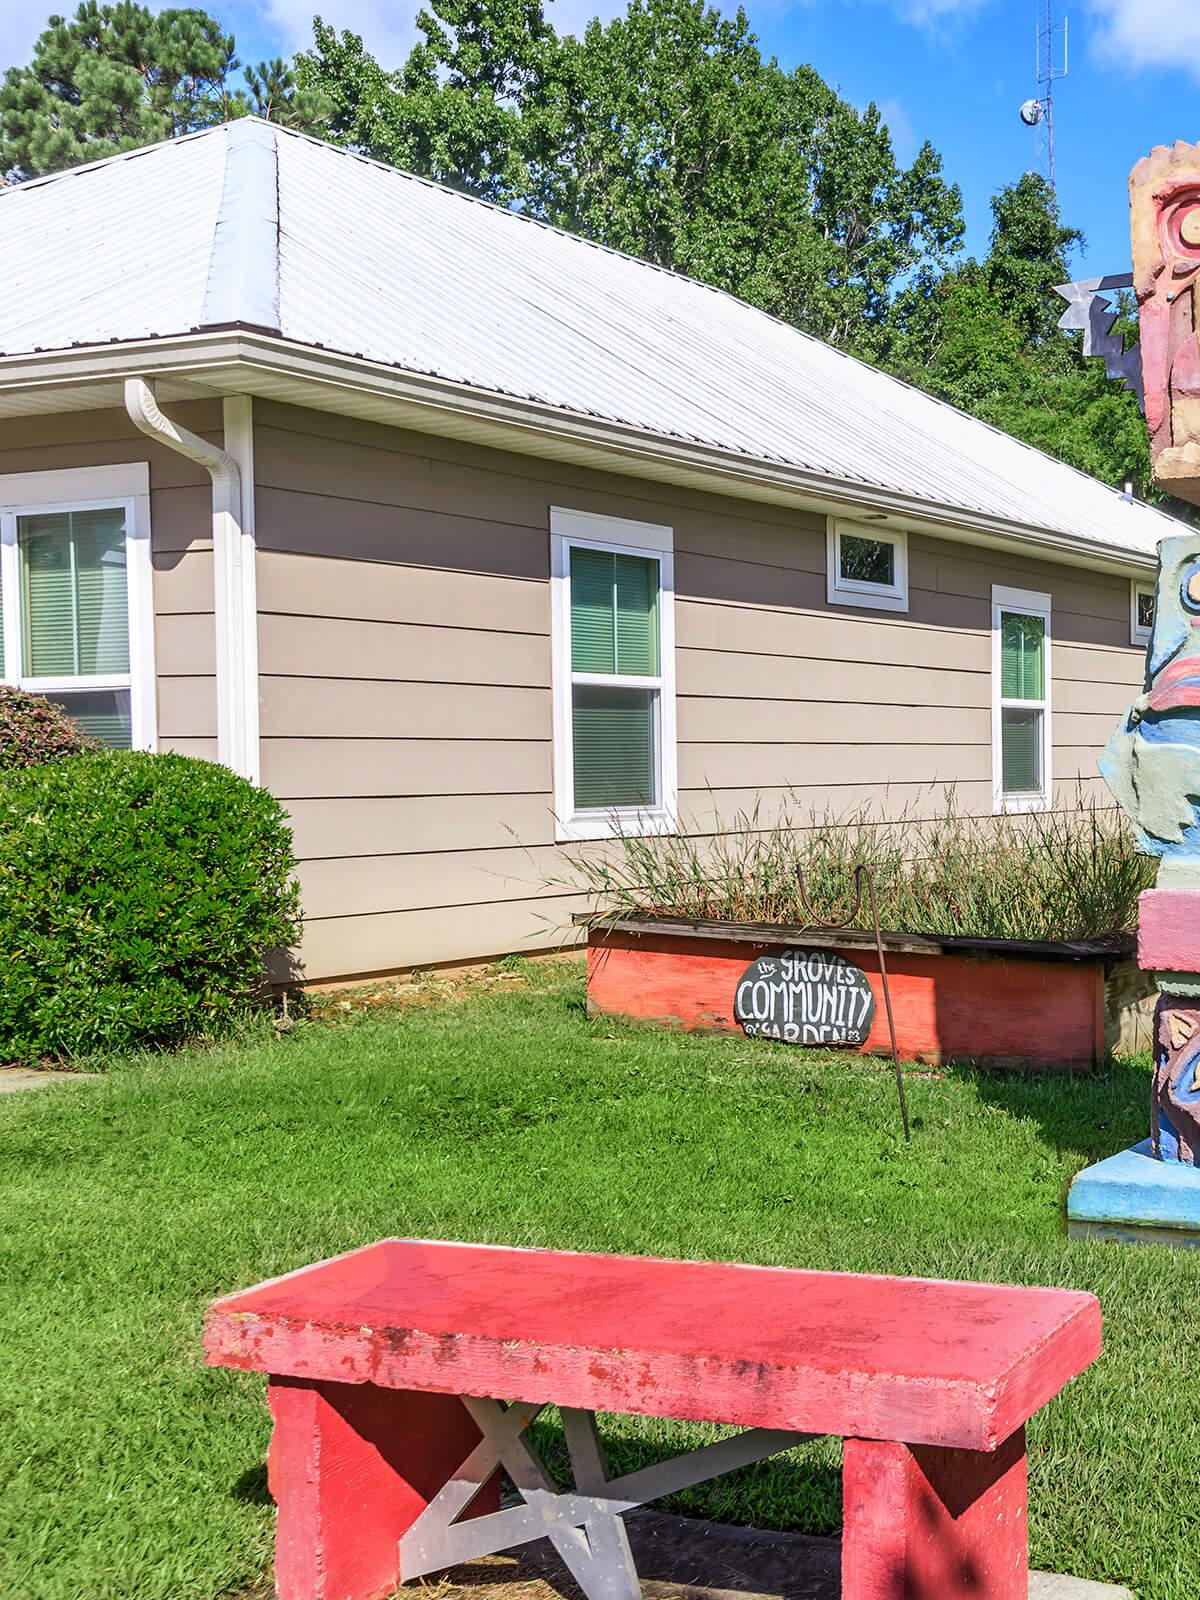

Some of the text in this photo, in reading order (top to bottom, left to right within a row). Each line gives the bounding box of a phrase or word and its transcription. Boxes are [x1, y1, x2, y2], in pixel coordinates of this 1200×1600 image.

[757, 950, 859, 986] the GROVES
[736, 980, 873, 1028] COMMUNITY
